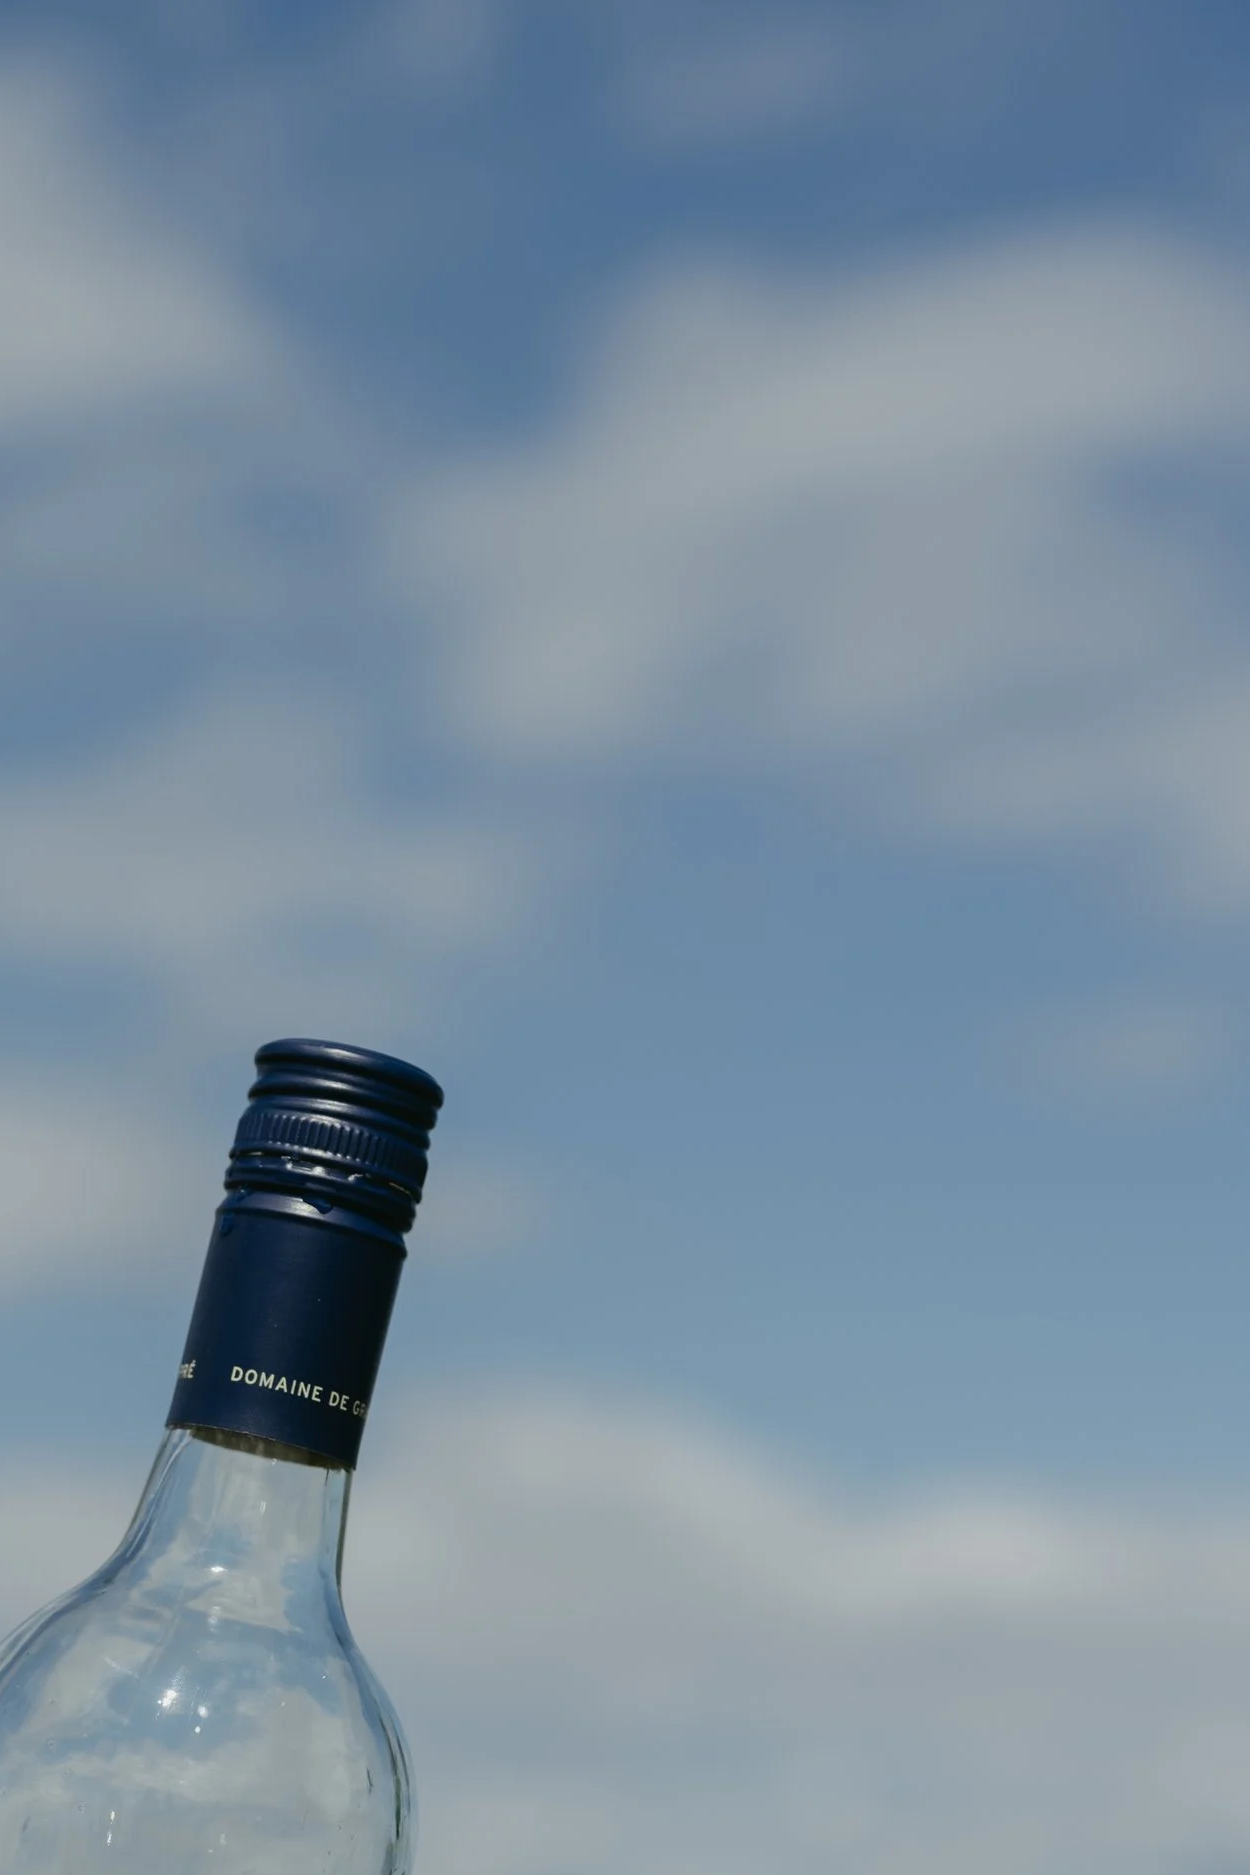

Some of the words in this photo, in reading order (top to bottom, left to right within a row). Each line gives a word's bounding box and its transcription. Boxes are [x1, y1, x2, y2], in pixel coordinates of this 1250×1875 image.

[179, 1359, 196, 1379] RÉ
[230, 1365, 324, 1403] DOMAINE
[328, 1391, 350, 1411] DE
[352, 1400, 367, 1419] GR
